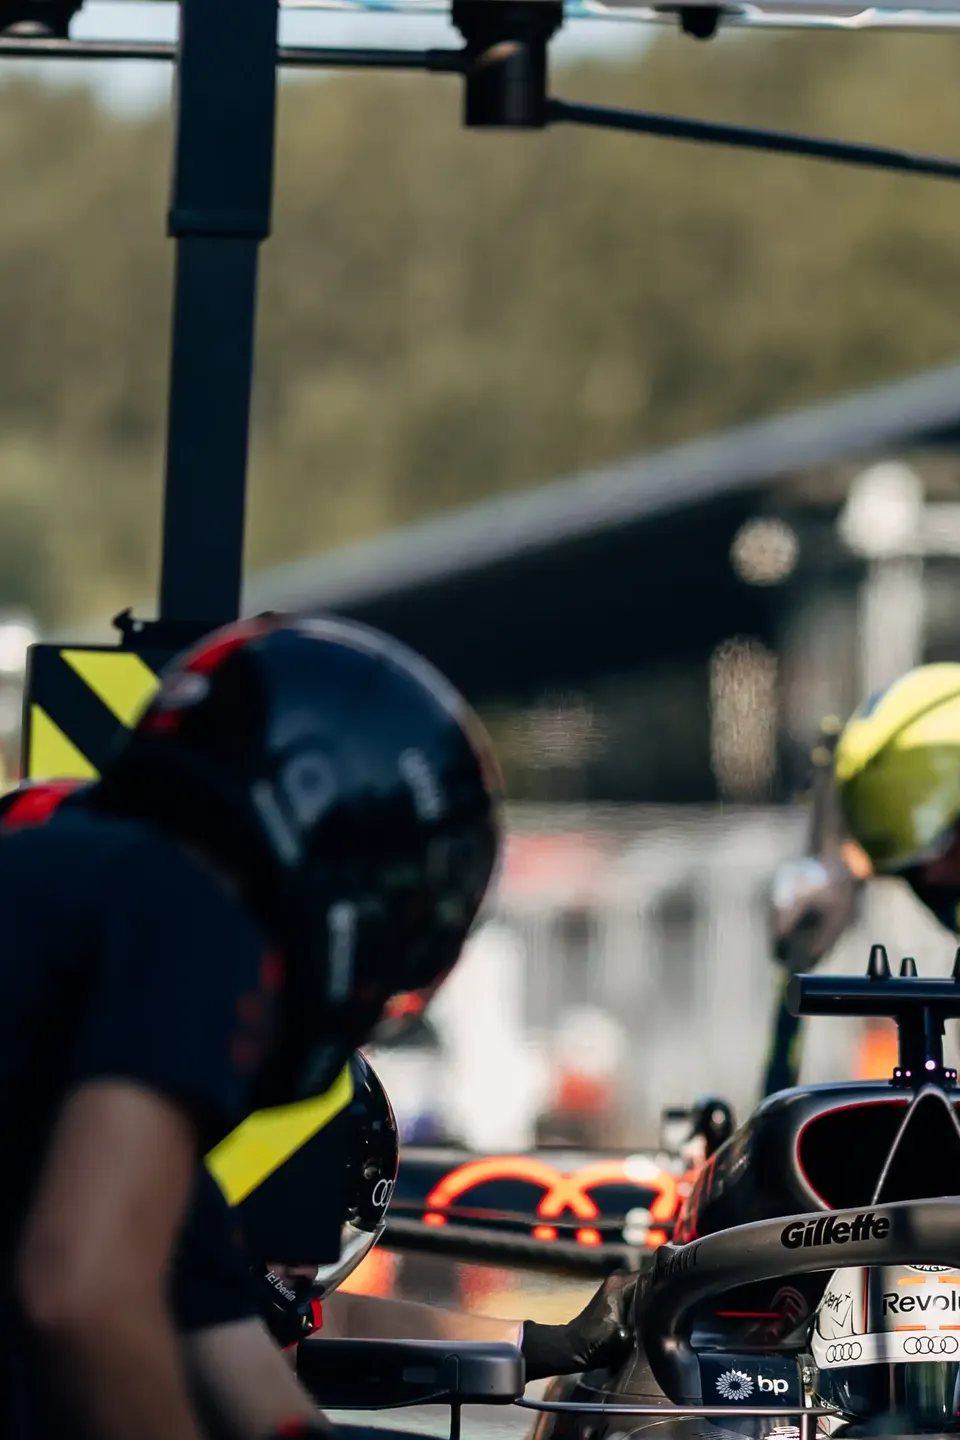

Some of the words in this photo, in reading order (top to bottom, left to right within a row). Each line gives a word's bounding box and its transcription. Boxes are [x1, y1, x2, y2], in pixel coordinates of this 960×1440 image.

[780, 1213, 890, 1249] Gillette
[274, 1280, 296, 1301] berlin
[757, 1375, 789, 1396] bp
